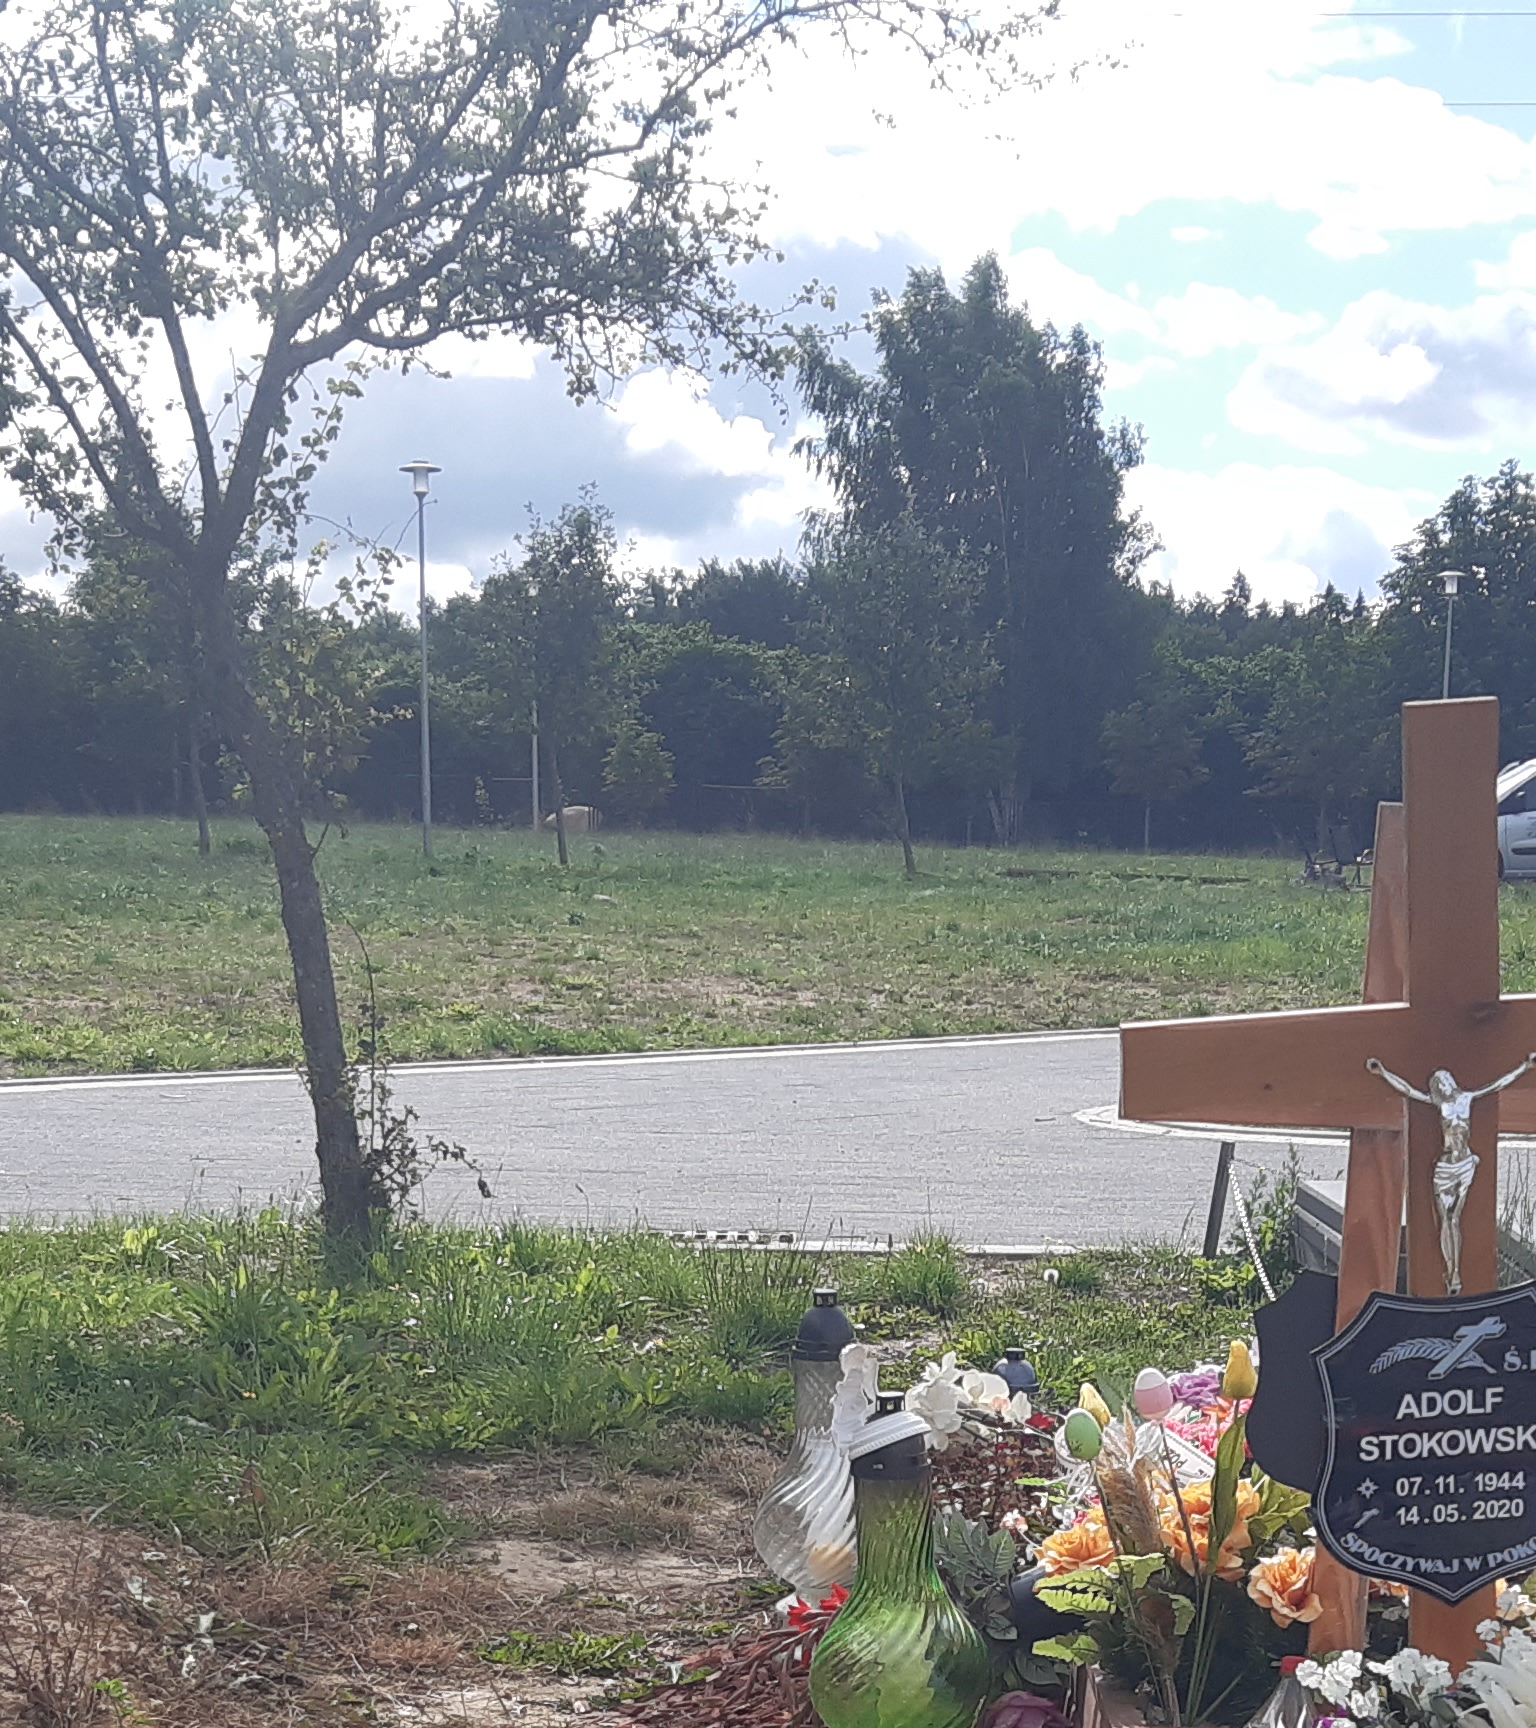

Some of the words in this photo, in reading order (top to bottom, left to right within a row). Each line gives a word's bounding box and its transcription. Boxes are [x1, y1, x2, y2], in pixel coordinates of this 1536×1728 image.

[1395, 1386, 1504, 1420] ADOLF
[1340, 1531, 1460, 1574] SPOCZYWAJ
[1464, 1556, 1483, 1572] W
